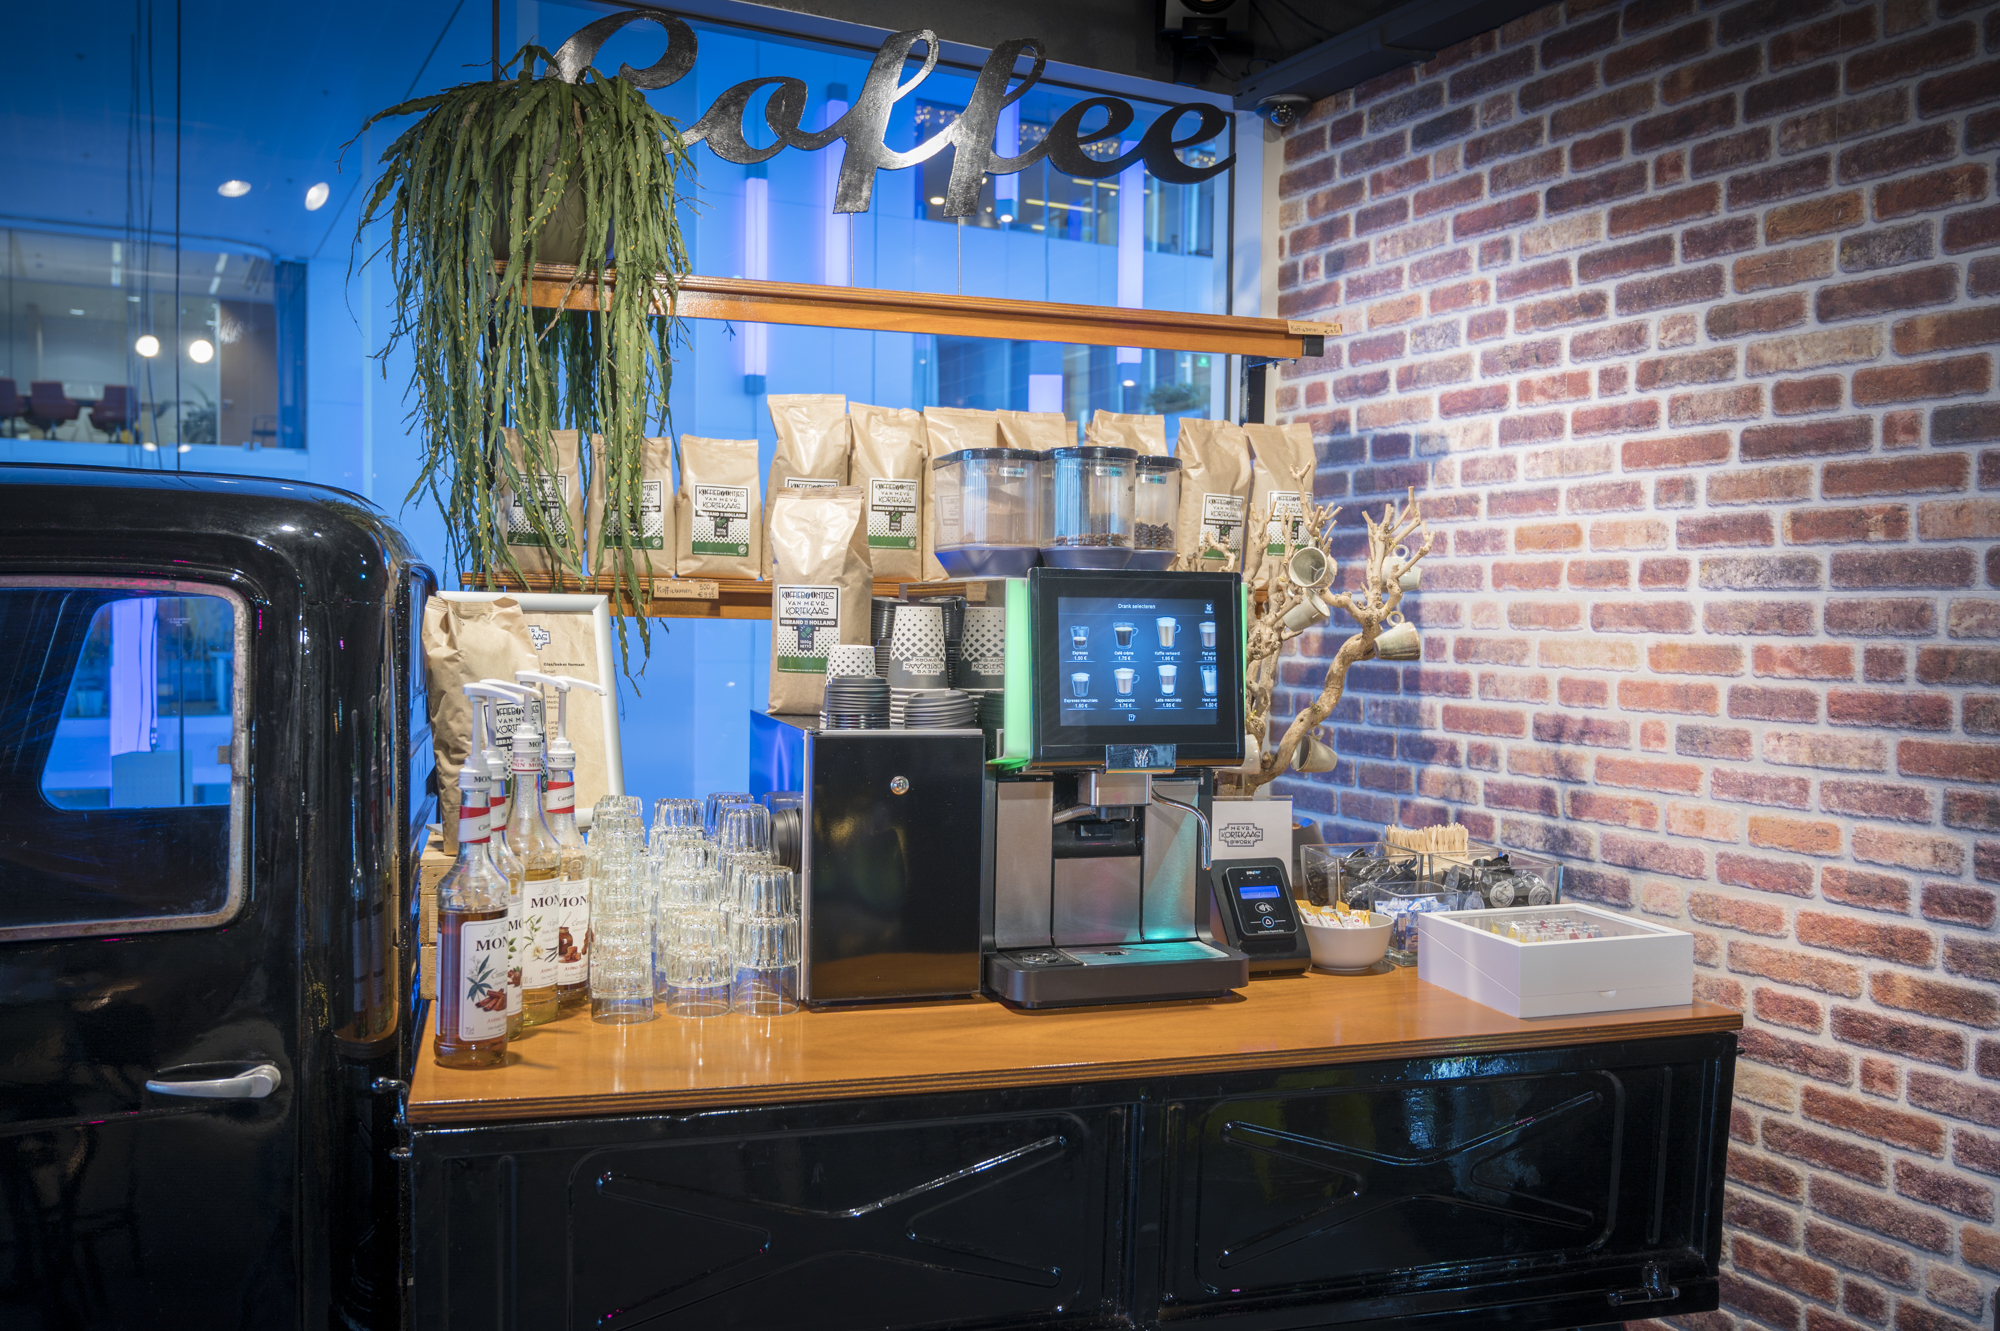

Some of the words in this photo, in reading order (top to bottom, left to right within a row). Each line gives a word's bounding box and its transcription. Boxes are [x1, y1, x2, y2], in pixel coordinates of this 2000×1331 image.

[544, 10, 1237, 217] Coffee
[698, 489, 745, 499] KOFFIEBOONTJES
[781, 591, 835, 601] KOFFIEBOONTJES
[785, 606, 830, 616] KORTEKAAS
[1220, 831, 1261, 839] KORTEKAAS
